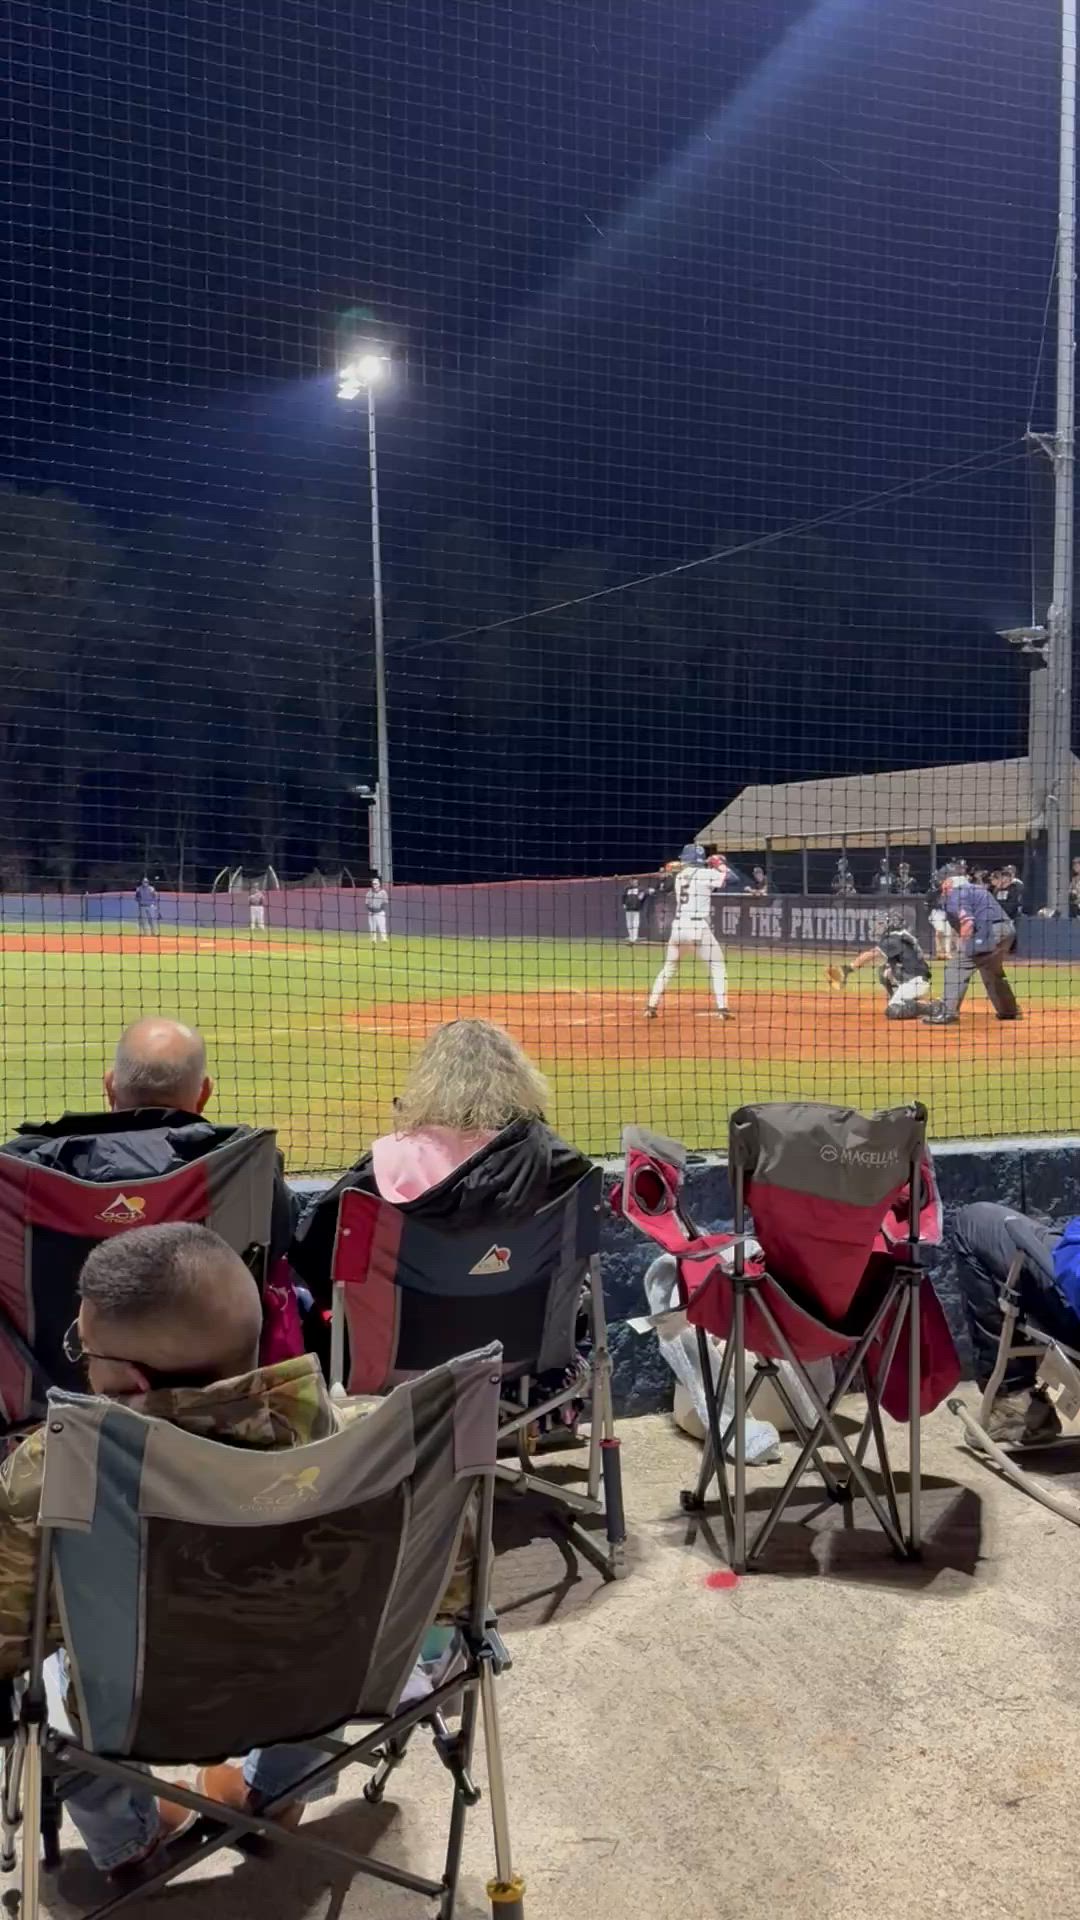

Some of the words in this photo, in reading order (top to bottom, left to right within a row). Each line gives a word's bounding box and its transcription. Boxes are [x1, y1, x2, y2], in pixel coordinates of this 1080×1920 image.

[680, 884, 690, 905] 5
[722, 906, 741, 935] OF
[749, 906, 782, 937] THE
